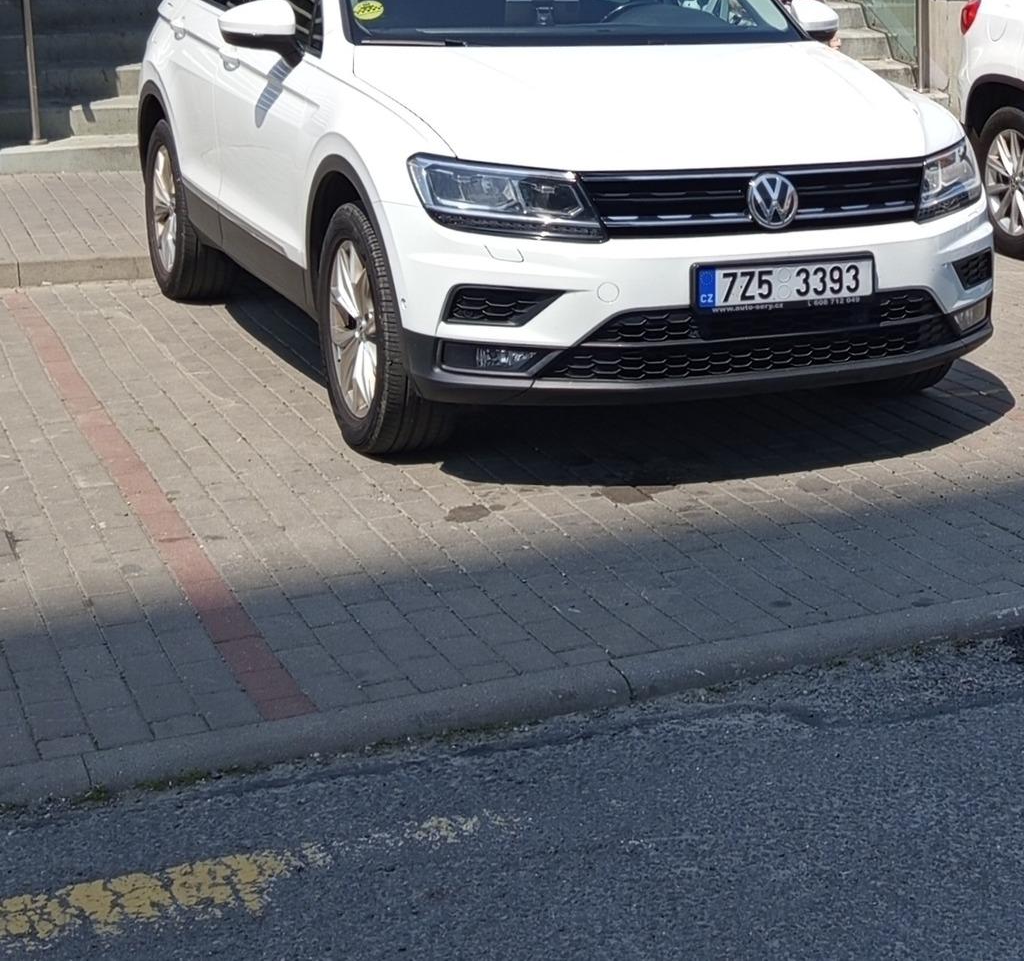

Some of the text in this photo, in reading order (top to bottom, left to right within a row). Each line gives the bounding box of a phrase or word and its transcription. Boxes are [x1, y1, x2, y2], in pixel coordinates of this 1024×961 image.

[722, 264, 860, 304] 7Z5 3393
[700, 294, 714, 304] CZ
